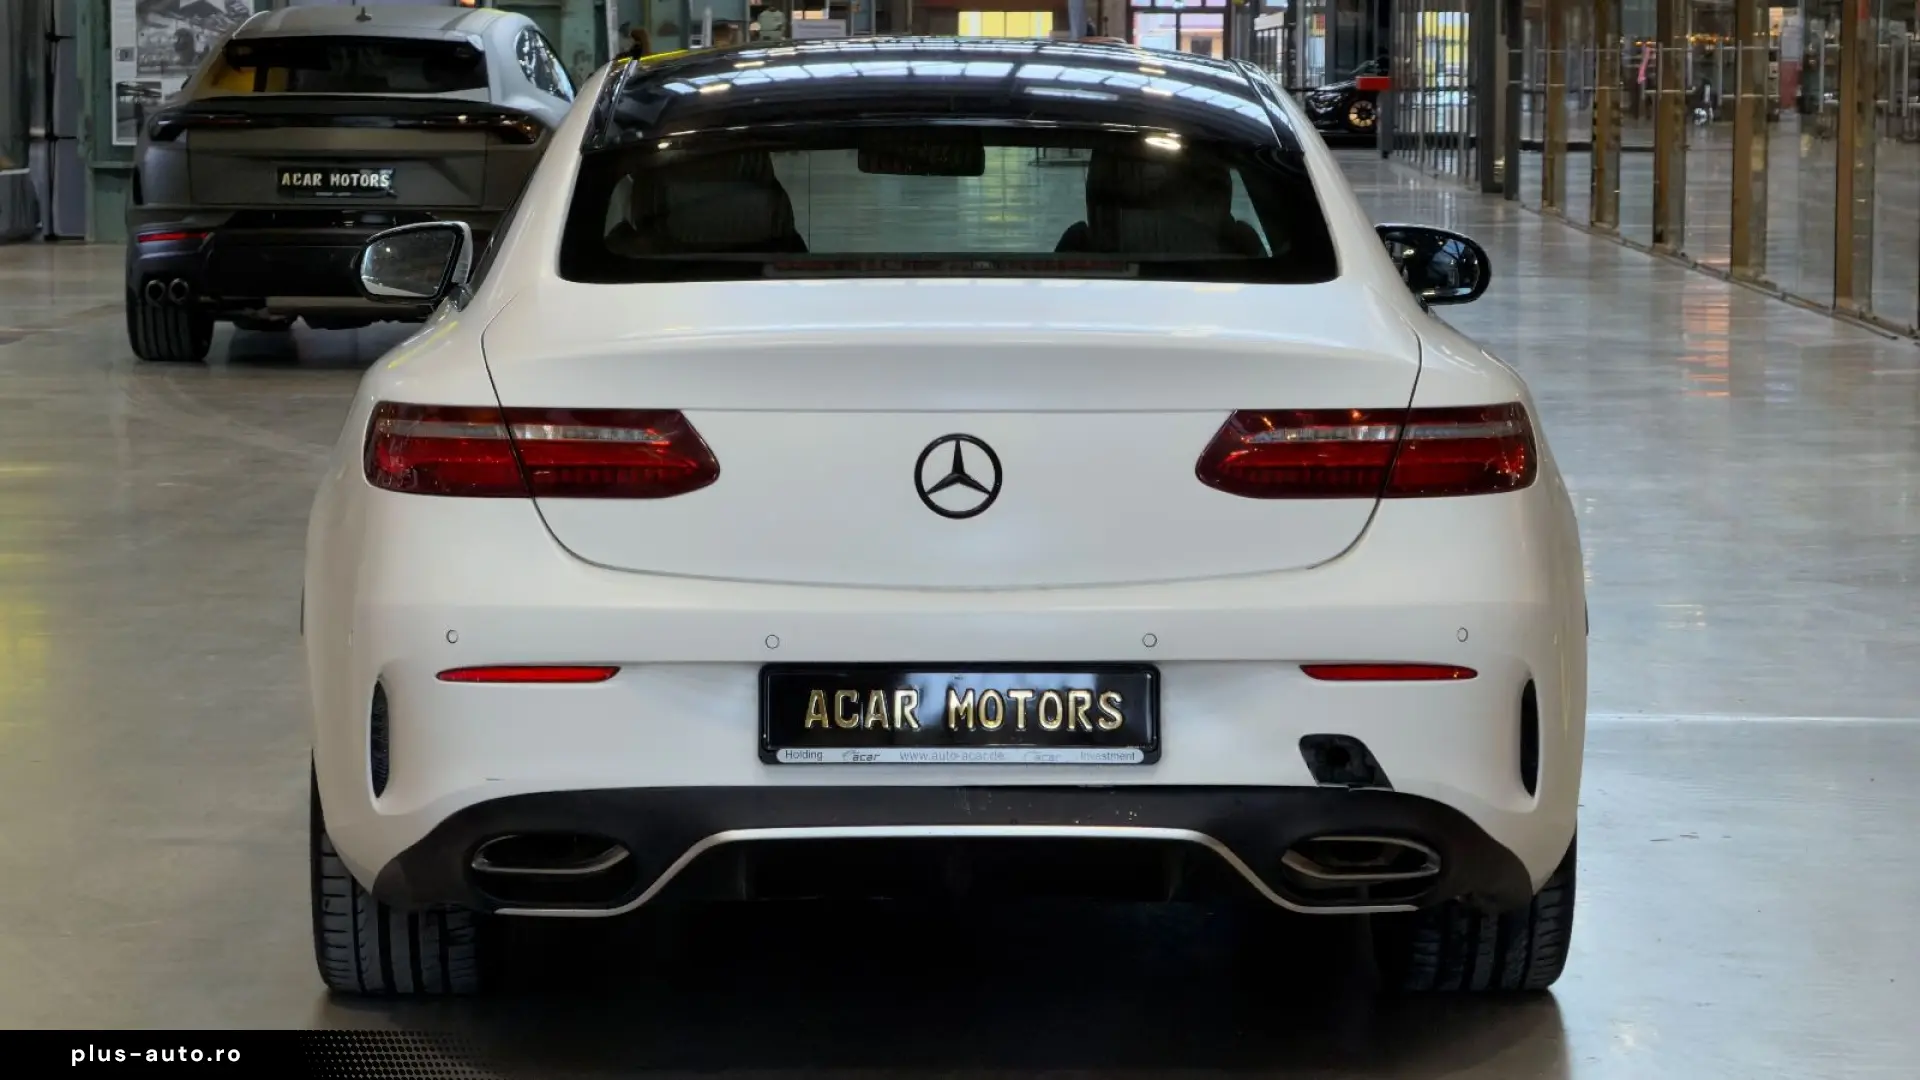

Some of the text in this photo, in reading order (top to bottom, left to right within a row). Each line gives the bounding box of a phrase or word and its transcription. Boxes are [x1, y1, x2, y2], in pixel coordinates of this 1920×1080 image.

[281, 172, 391, 188] ACAR MOTORS
[803, 688, 1124, 732] ACAR MOTORS
[784, 749, 823, 762] Holding
[1080, 750, 1135, 762] Investment
